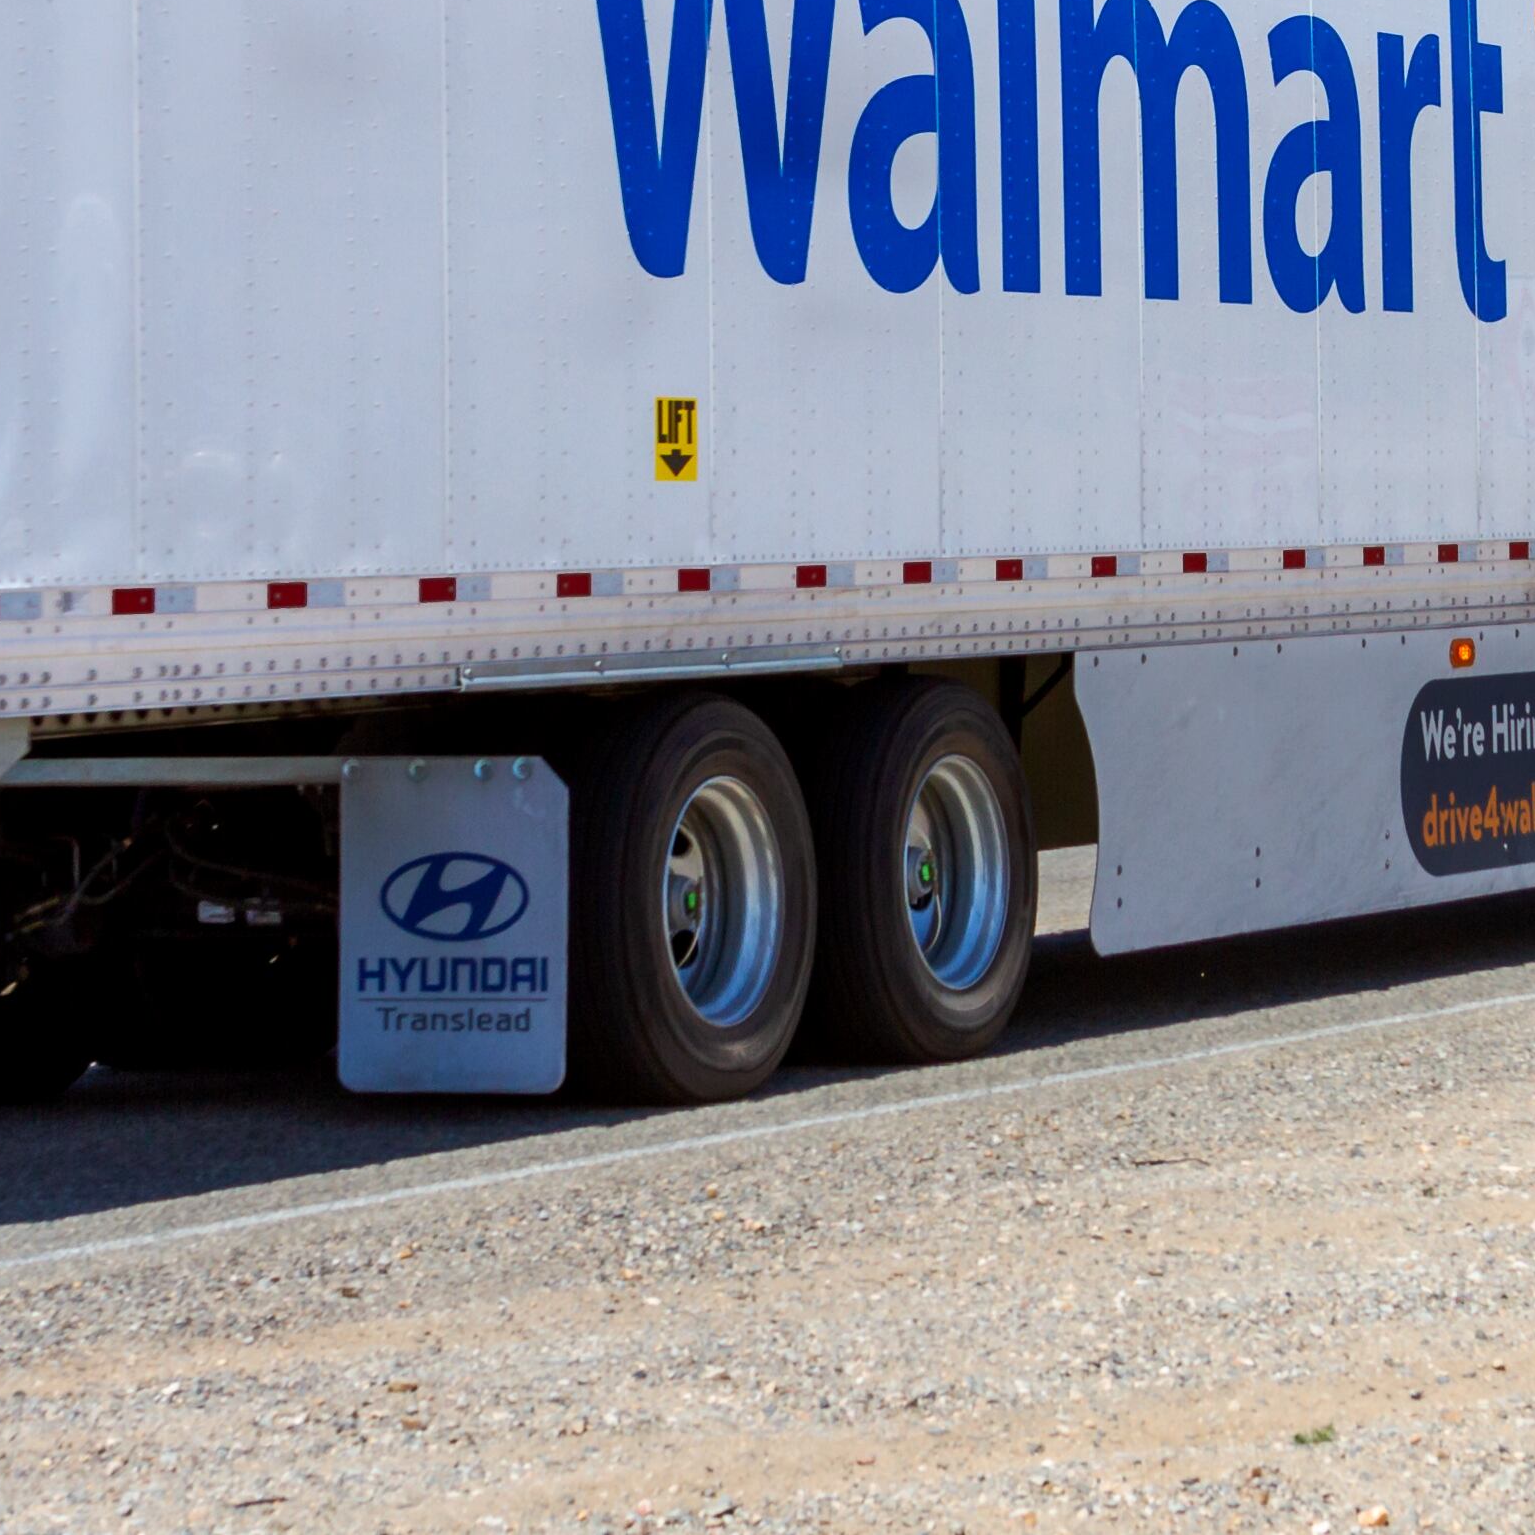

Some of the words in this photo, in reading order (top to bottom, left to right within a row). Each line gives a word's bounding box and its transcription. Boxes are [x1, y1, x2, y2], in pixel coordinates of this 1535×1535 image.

[658, 400, 695, 444] LIFT
[1420, 707, 1485, 761] We're
[357, 956, 549, 993] HYUNDAI
[376, 1007, 532, 1032] Translead
